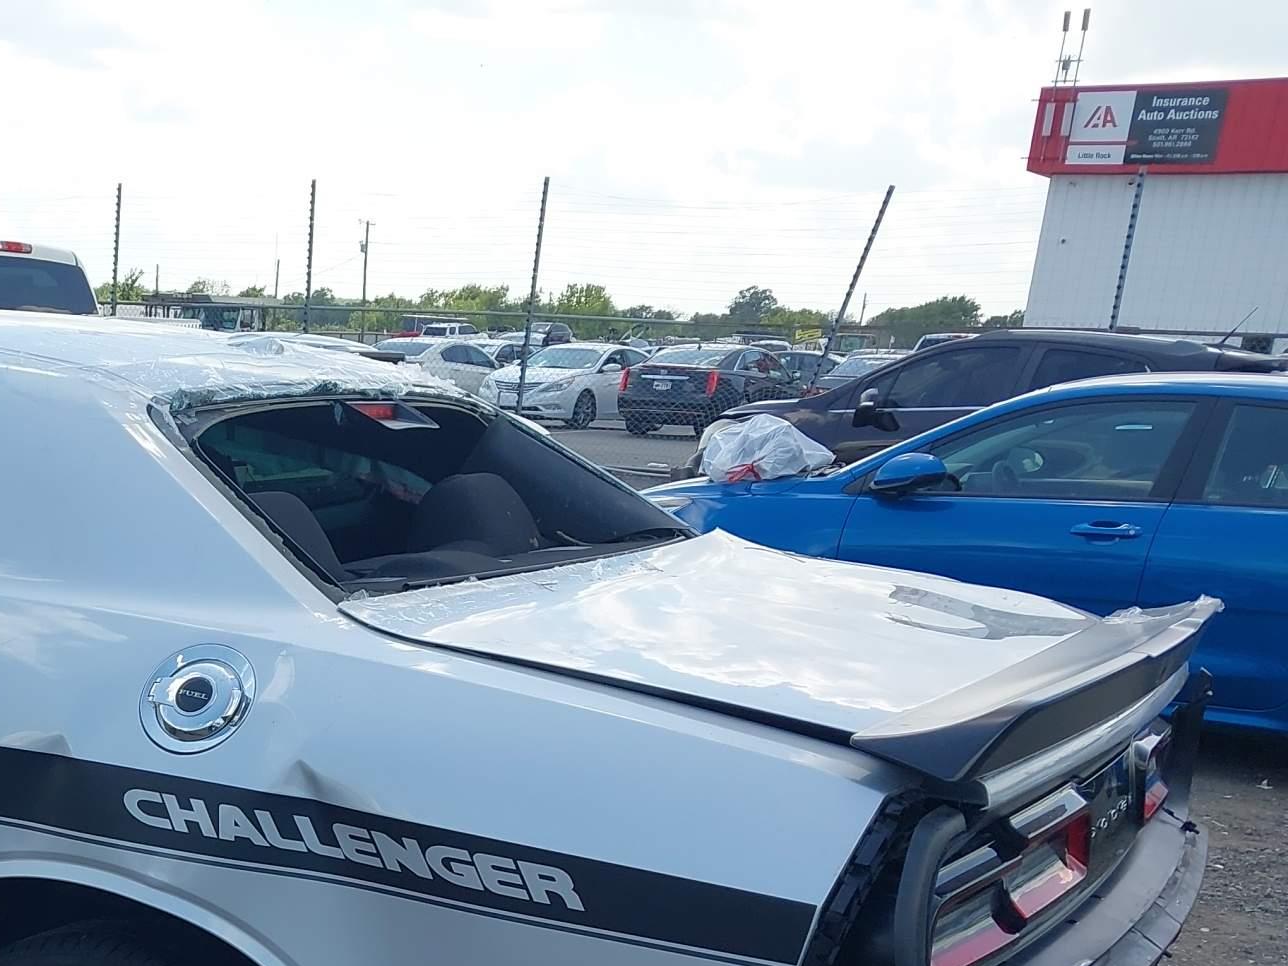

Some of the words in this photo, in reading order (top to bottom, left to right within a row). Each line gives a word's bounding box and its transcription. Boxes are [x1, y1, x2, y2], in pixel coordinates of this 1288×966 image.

[1152, 95, 1210, 108] Insurance
[1138, 109, 1164, 121] Auto
[1167, 107, 1220, 121] Auctions
[178, 689, 209, 700] FUEL
[123, 788, 585, 911] CHALLENGER
